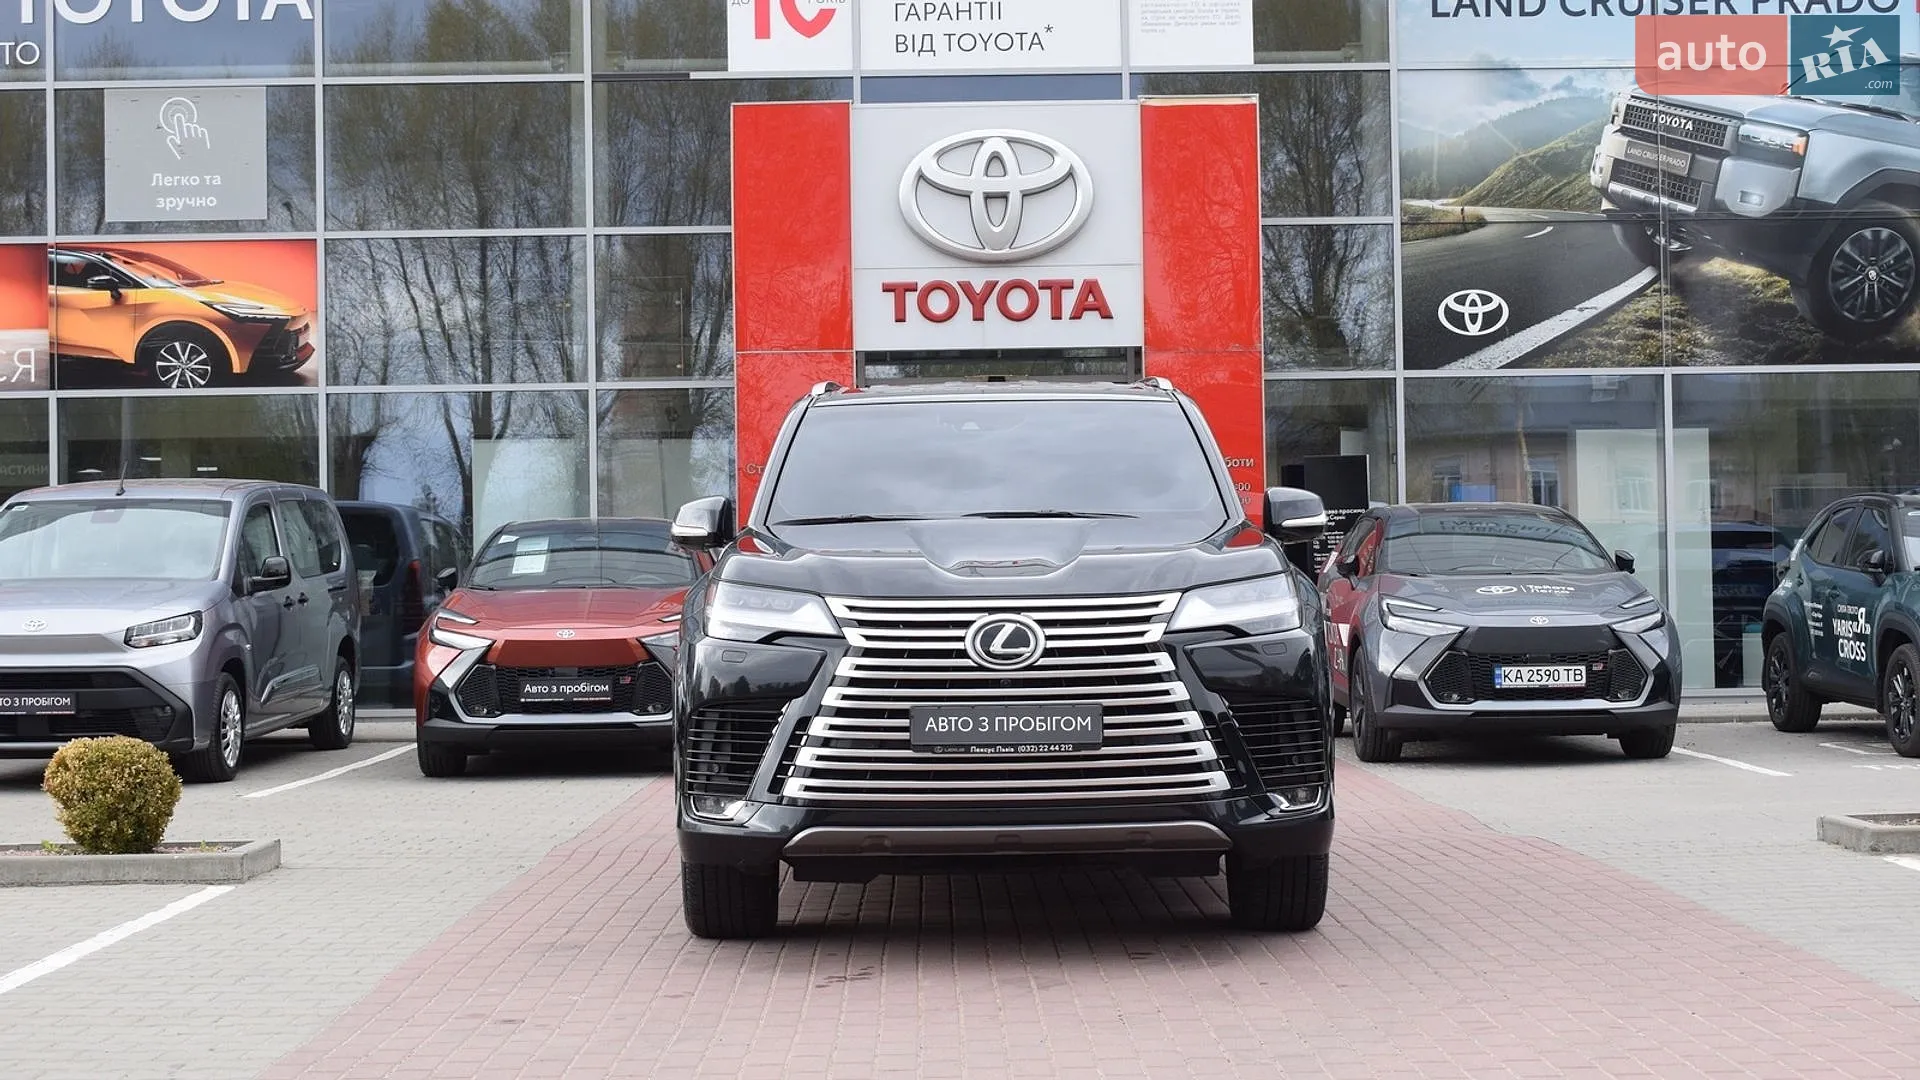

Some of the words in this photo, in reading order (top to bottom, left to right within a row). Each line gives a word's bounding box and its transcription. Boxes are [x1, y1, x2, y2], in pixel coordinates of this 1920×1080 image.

[895, 33, 936, 57] ВІД
[1652, 113, 1693, 131] TOYOTA
[150, 172, 200, 186] Легко
[203, 175, 222, 185] та
[155, 196, 217, 211] зручно
[881, 278, 1114, 323] TOYOTA
[1832, 618, 1854, 638] YARIS
[1838, 638, 1867, 662] CROSS
[1527, 668, 1560, 683] 2590
[524, 683, 549, 693] Авто
[560, 682, 609, 694] пробігом
[22, 697, 71, 706] ПРОБІГОМ
[925, 716, 974, 732] АВТО
[994, 716, 1092, 732] ПРОБІГОМ
